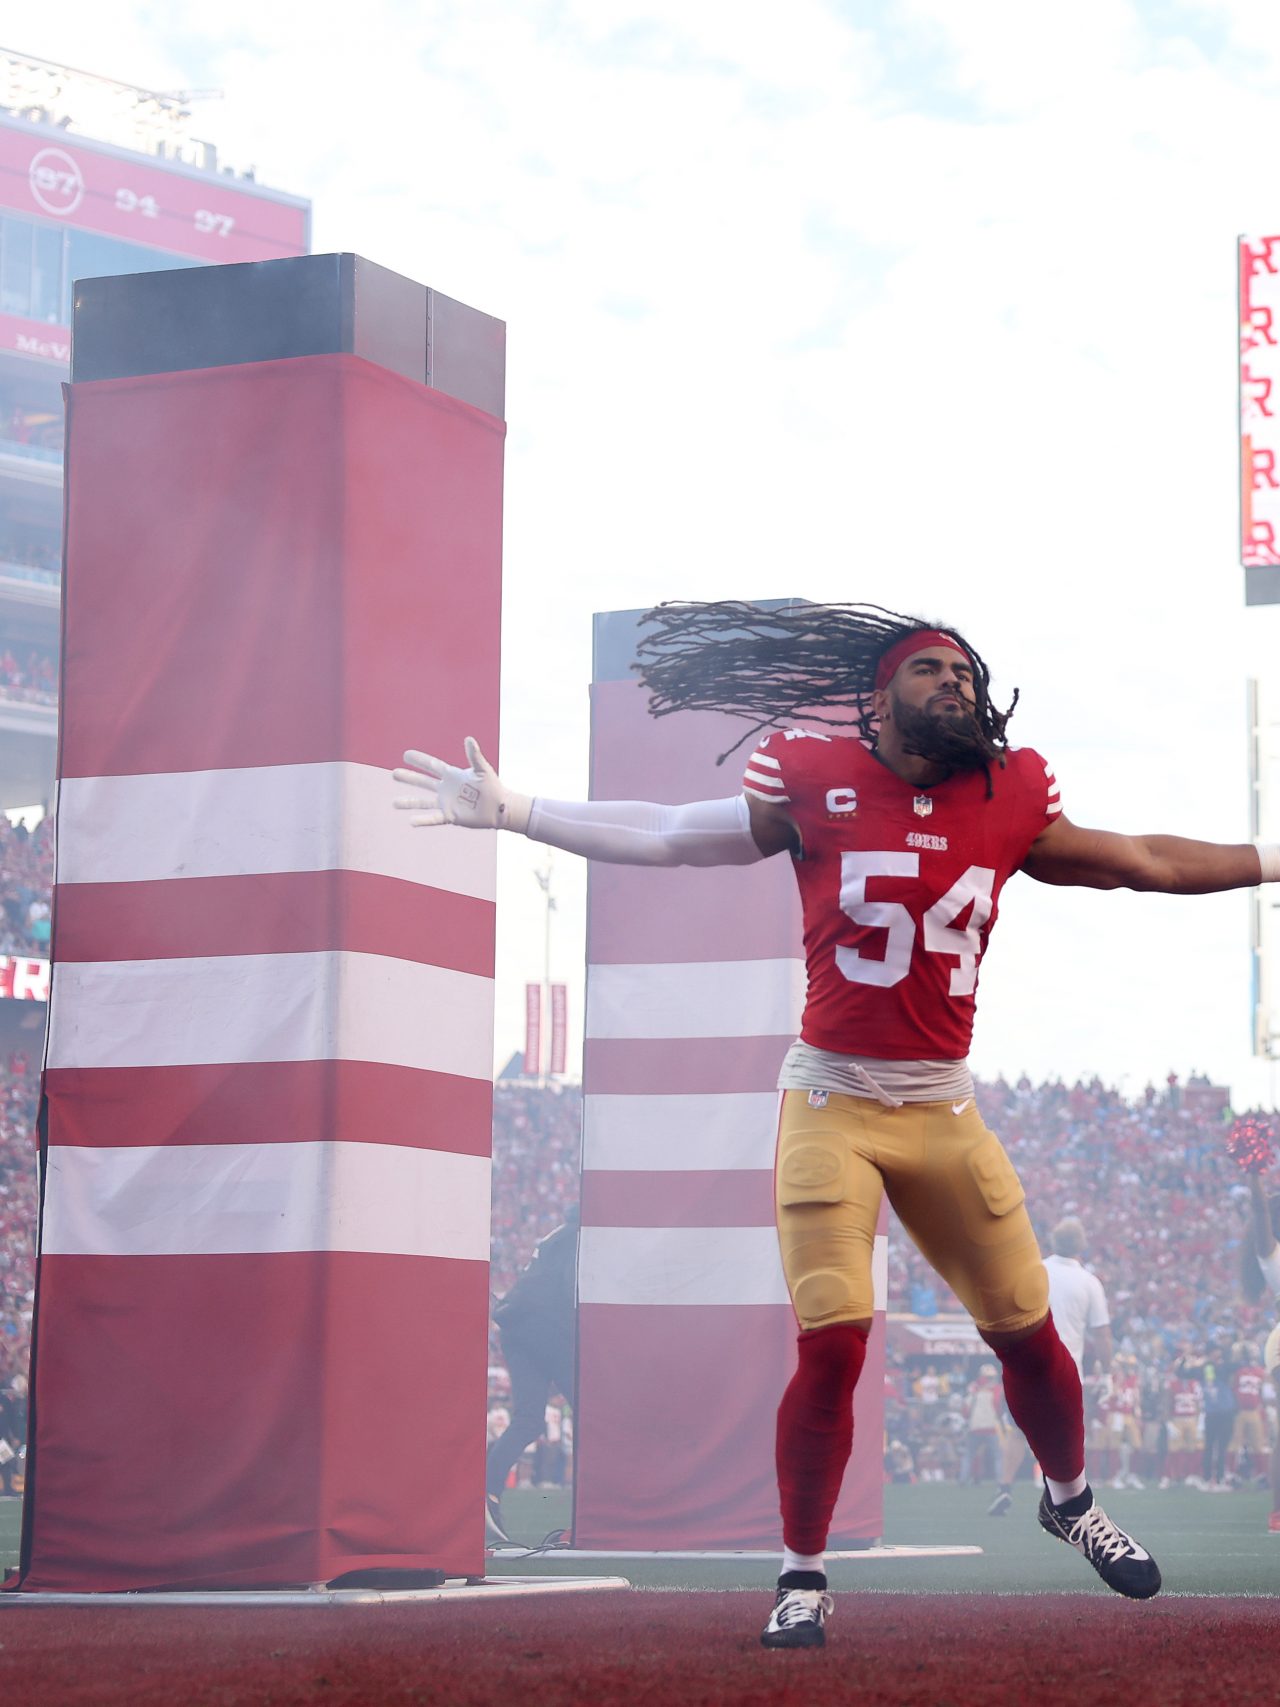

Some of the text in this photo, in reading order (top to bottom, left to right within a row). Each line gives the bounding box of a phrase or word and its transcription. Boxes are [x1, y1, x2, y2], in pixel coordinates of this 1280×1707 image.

[16, 333, 70, 361] McV
[826, 788, 857, 813] C
[905, 832, 948, 851] 49ERS
[835, 851, 996, 997] 54
